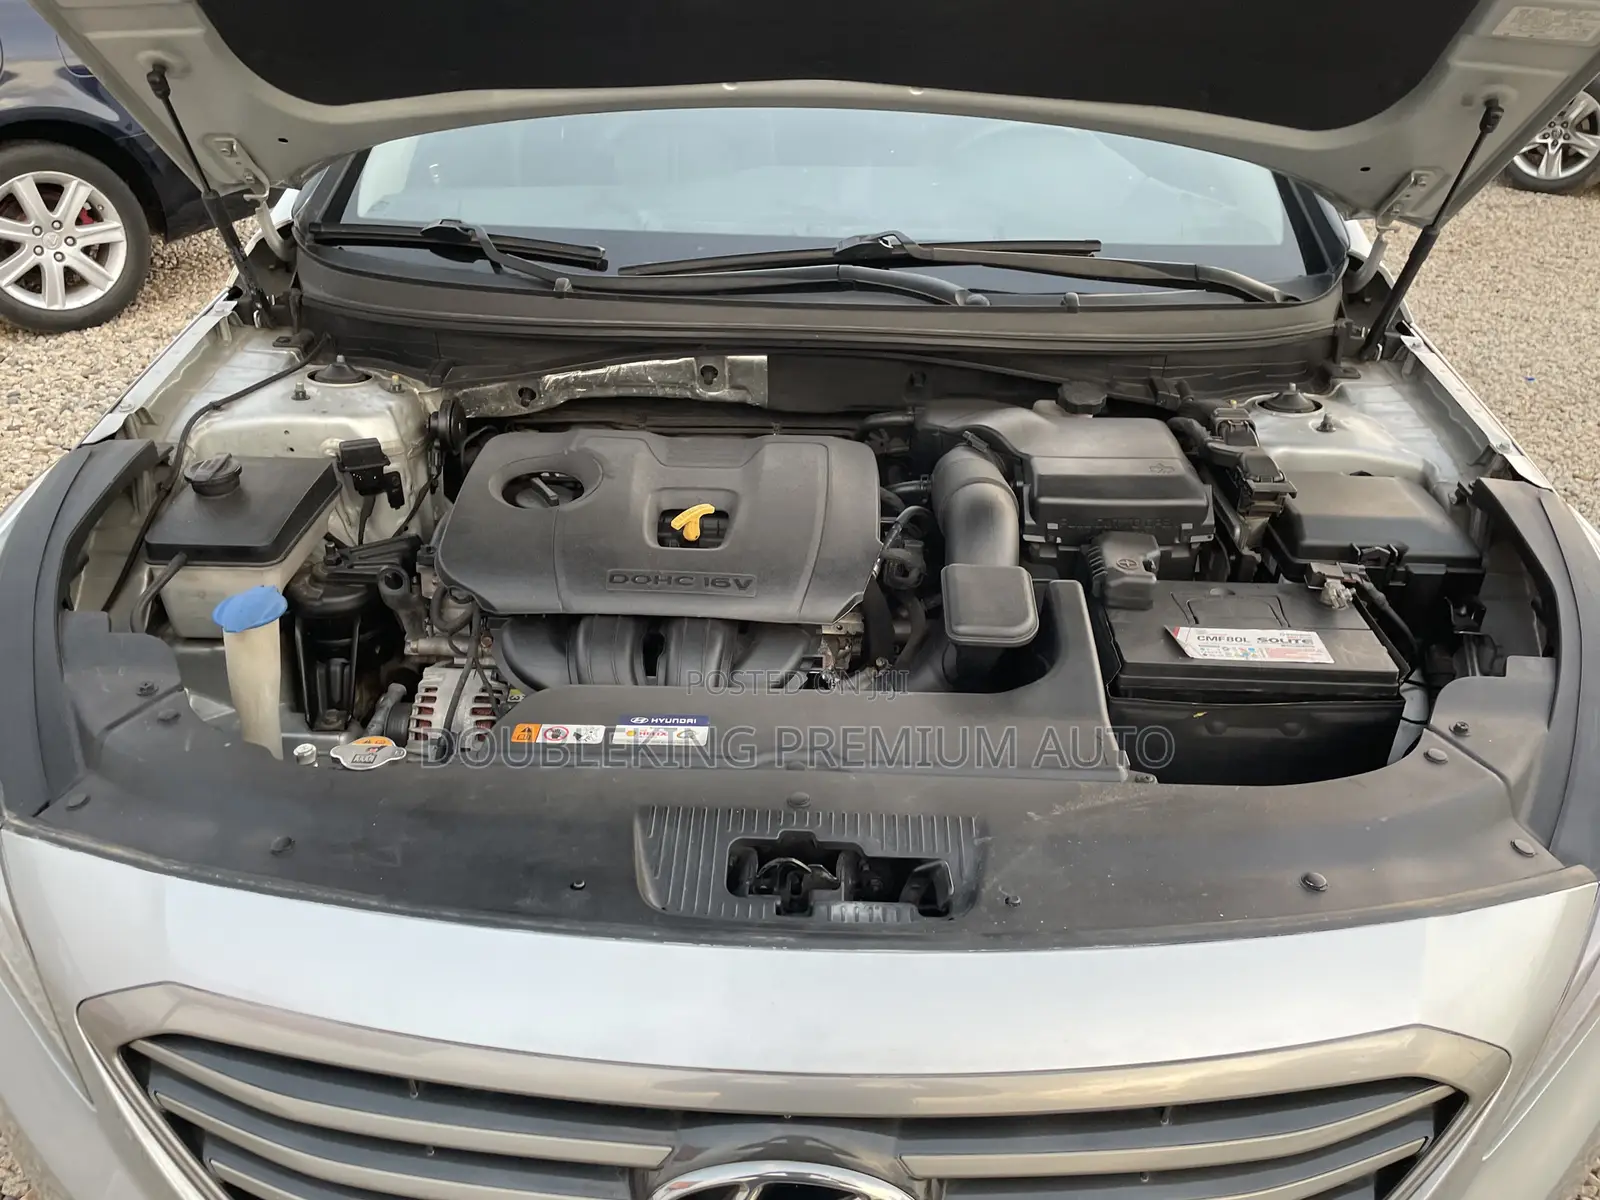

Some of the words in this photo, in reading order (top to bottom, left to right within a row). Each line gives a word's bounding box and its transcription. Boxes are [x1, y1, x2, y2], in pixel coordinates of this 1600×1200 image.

[608, 573, 694, 586] DOHC
[704, 576, 754, 591] 16V
[1257, 637, 1314, 645] SOLITE
